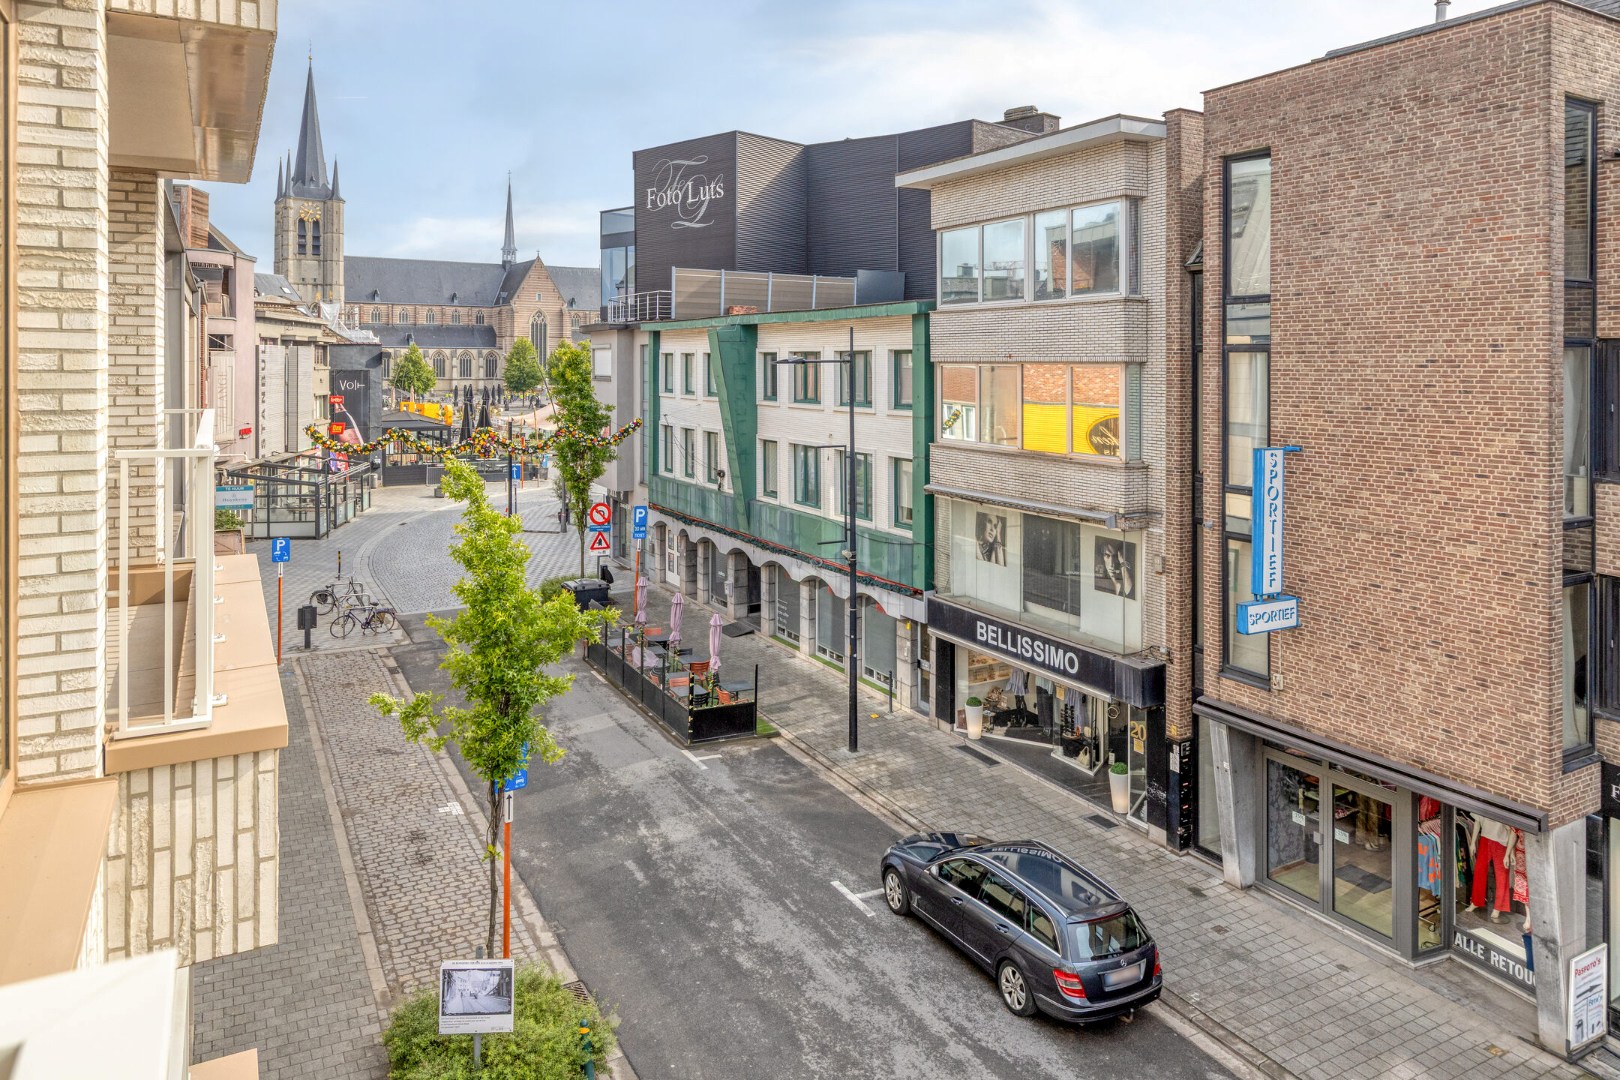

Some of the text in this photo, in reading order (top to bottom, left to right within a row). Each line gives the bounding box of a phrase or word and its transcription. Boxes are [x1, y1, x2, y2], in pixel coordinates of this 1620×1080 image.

[646, 181, 724, 209] Foto Luts
[635, 508, 646, 523] P
[276, 539, 286, 552] P
[1248, 606, 1296, 626] SPORTIEF
[975, 620, 1080, 675] BELLISSIMO
[1130, 720, 1147, 742] 20
[1454, 932, 1537, 987] ALLE RETOU
